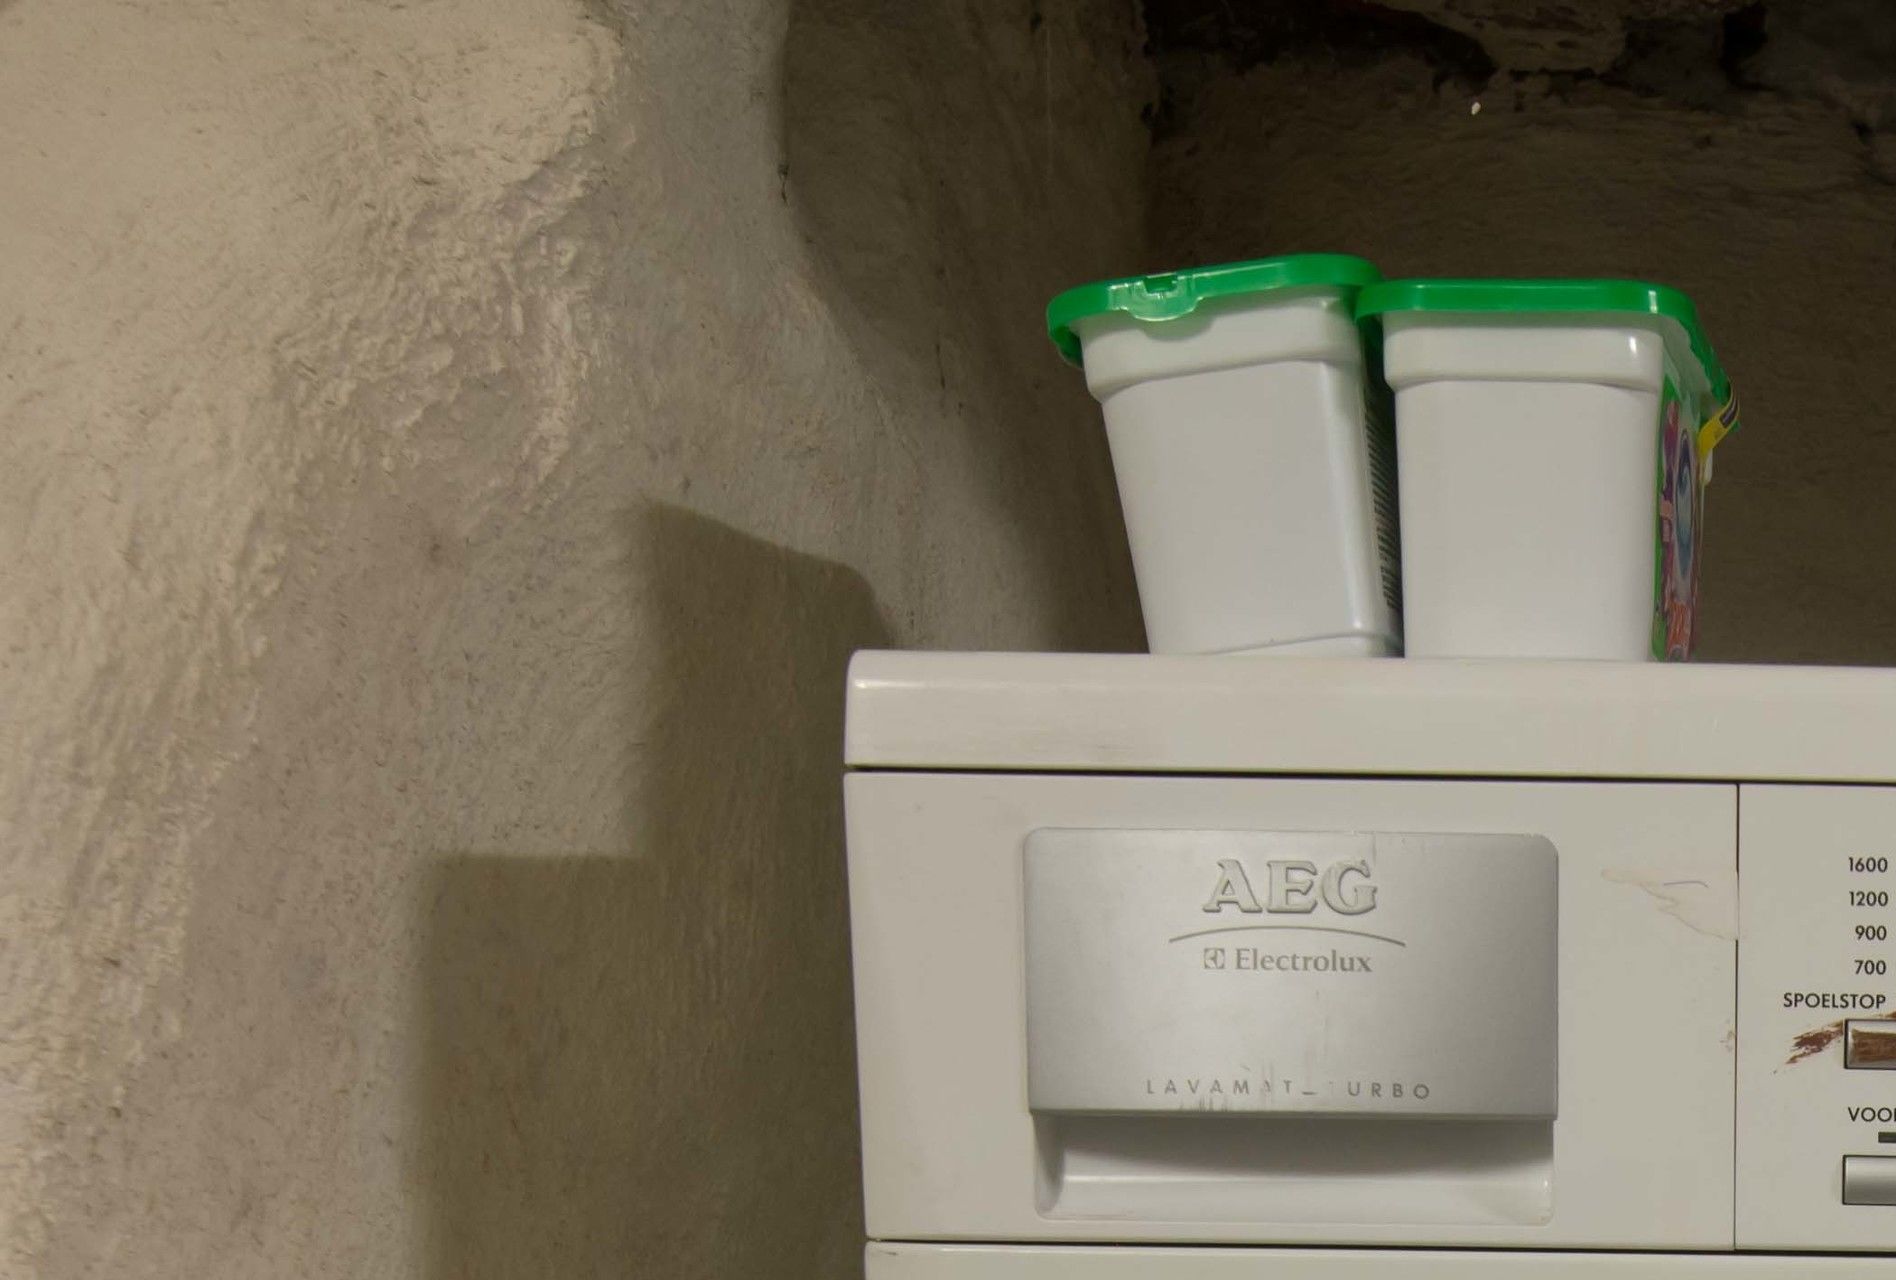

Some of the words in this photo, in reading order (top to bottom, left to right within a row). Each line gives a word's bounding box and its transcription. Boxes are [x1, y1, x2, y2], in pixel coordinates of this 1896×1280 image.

[1848, 856, 1888, 873] 1600
[1202, 858, 1378, 916] AEG
[1849, 890, 1889, 907] 1200
[1854, 924, 1888, 941] 900
[1235, 948, 1372, 973] Electrolux
[1854, 959, 1887, 976] 700
[1783, 992, 1886, 1010] SPOELSTOP
